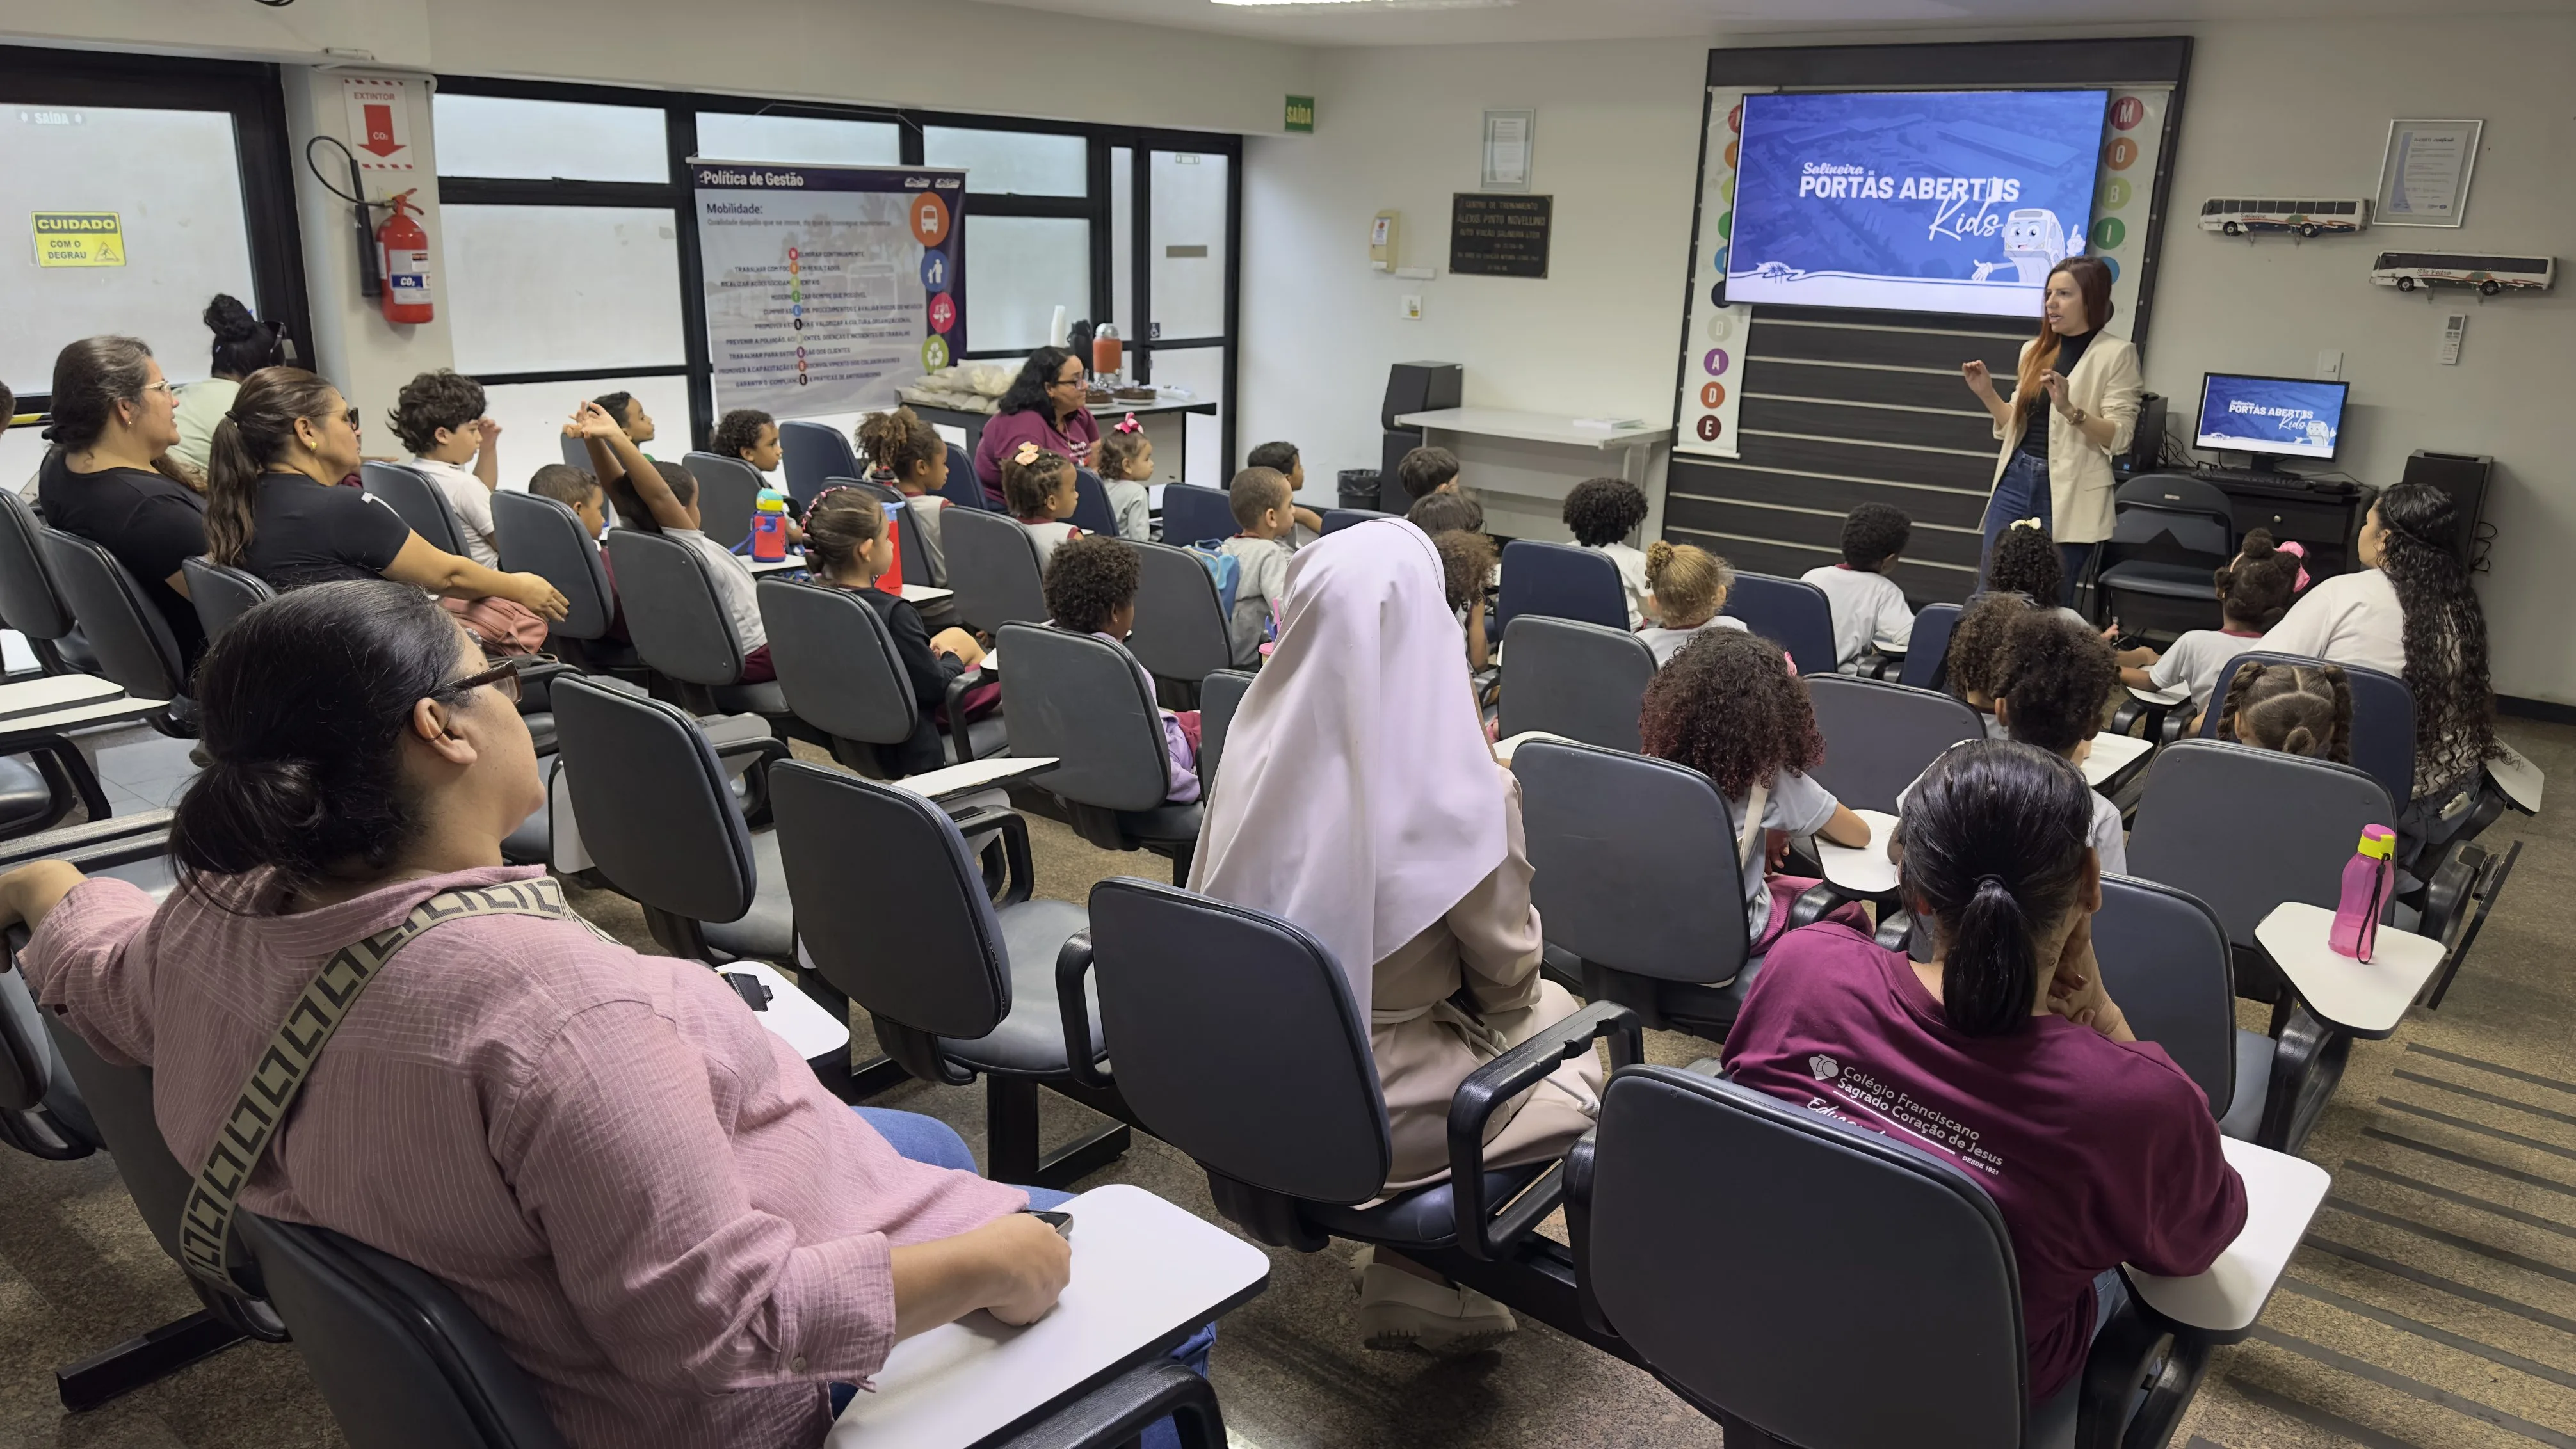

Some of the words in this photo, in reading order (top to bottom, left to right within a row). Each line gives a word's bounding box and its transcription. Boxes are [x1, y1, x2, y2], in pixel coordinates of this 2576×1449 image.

[354, 92, 396, 100] EXTINTOR
[34, 111, 70, 125] SAÍDA
[1287, 103, 1312, 124] SAÍDA
[1802, 161, 1865, 175] Salineira
[703, 170, 748, 186] Política
[749, 171, 764, 186] de
[765, 172, 805, 187] Gestão
[1799, 175, 1895, 200] PORTAS
[1899, 176, 2020, 202] ABERTS
[706, 202, 764, 214] Mobilidade:
[1928, 191, 2004, 241] Kids
[37, 219, 116, 230] CUIDADO
[50, 240, 71, 248] COM
[74, 240, 81, 248] O
[47, 251, 86, 259] DEGRAU
[2267, 407, 2314, 419] ABERTS
[2278, 412, 2306, 431] Kids
[1844, 1066, 1895, 1099] Colégio
[1897, 1093, 1979, 1141] Franciscano
[1837, 1077, 1889, 1111] Sagrado
[1892, 1105, 1946, 1139] Coração
[1948, 1134, 1966, 1149] de
[1967, 1142, 2004, 1166] Jesus
[1961, 1155, 1985, 1169] DESDE
[1984, 1165, 2000, 1176] 1921
